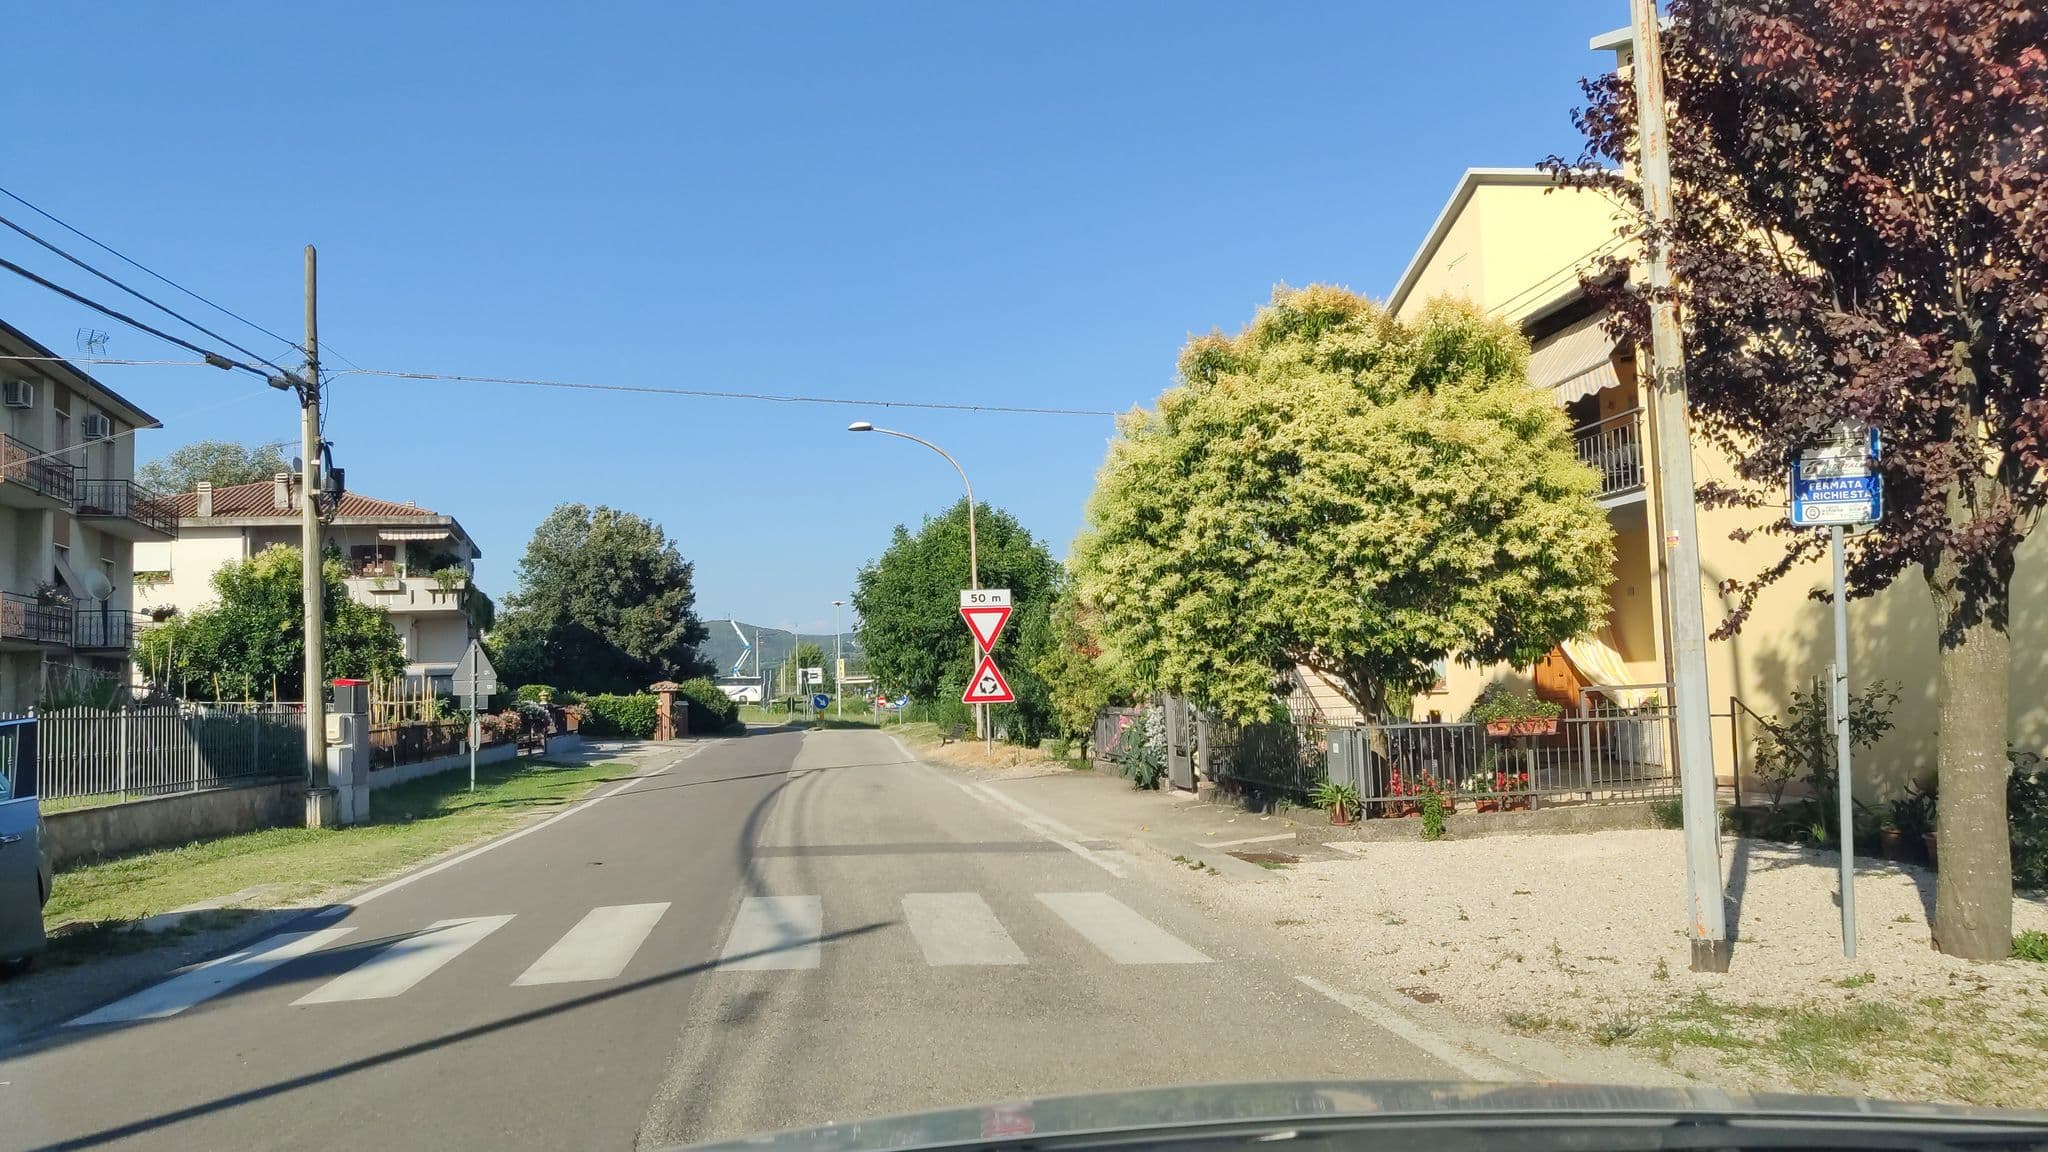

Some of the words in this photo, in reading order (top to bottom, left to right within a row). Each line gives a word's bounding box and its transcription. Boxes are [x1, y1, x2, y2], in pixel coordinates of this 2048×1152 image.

[1809, 480, 1862, 491] FERMATA
[1800, 493, 1809, 501] A
[1813, 490, 1872, 501] RICHIESTA
[971, 593, 986, 603] 50
